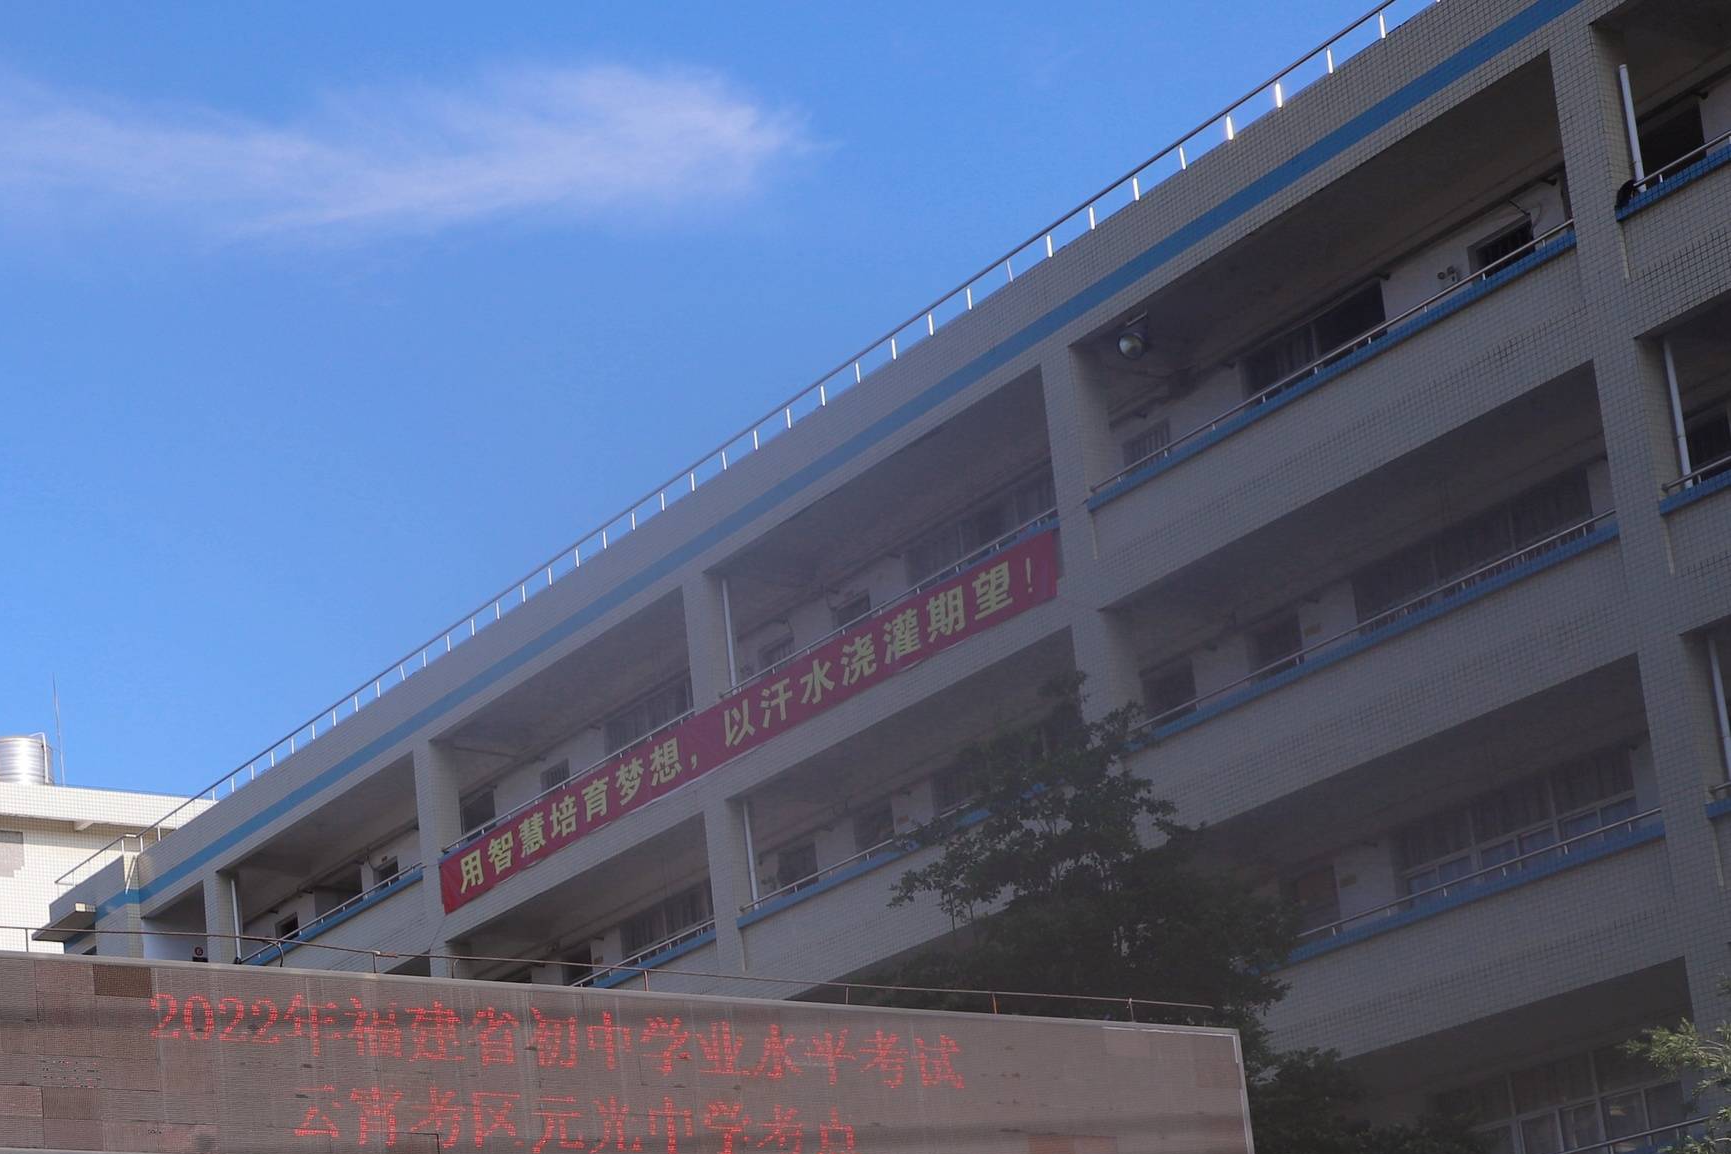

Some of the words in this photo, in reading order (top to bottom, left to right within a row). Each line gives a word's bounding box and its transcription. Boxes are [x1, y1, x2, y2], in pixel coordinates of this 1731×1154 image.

[149, 992, 965, 1090] 2022年福建省初中学业水平考试
